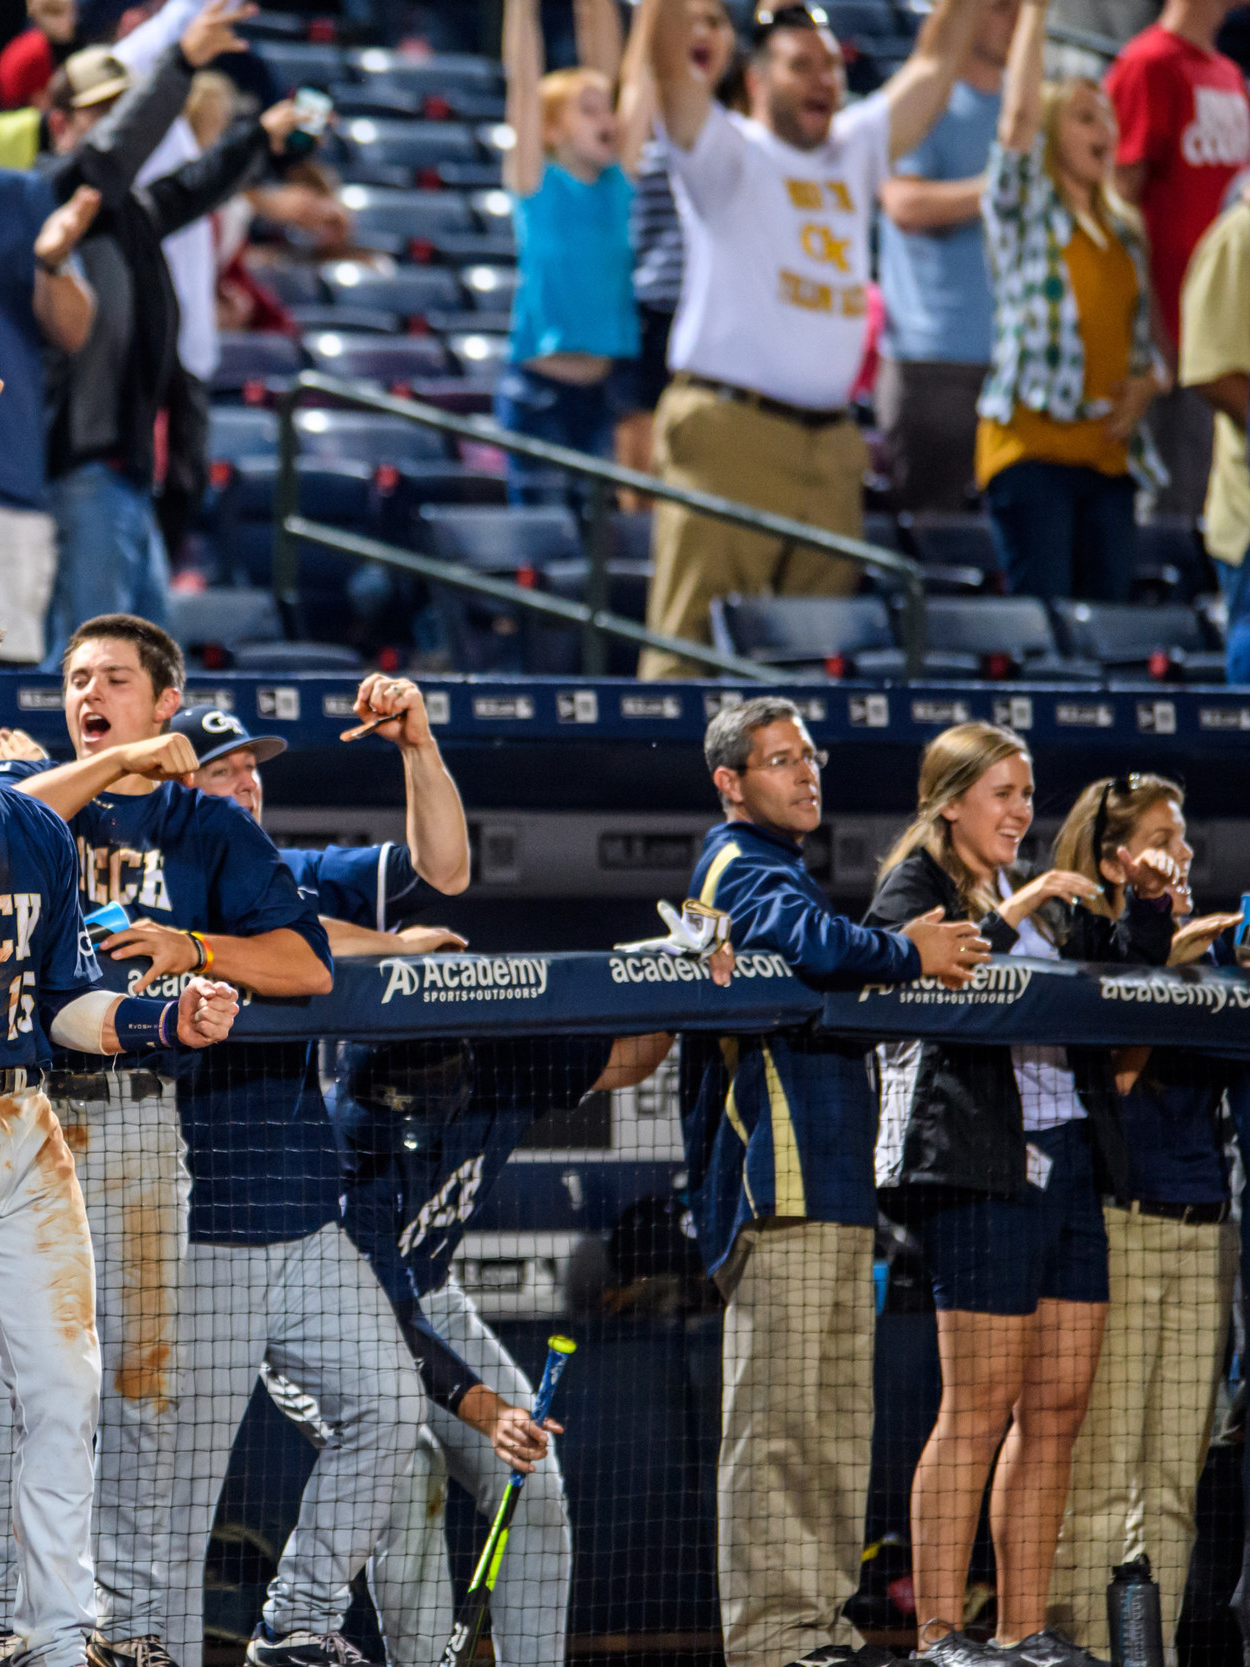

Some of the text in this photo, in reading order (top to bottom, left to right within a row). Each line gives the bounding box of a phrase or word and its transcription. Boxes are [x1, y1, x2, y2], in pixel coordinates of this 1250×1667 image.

[423, 957, 548, 994] Academy
[7, 971, 36, 1041] 15
[423, 987, 538, 1003] SPORTS+OUTDOORS
